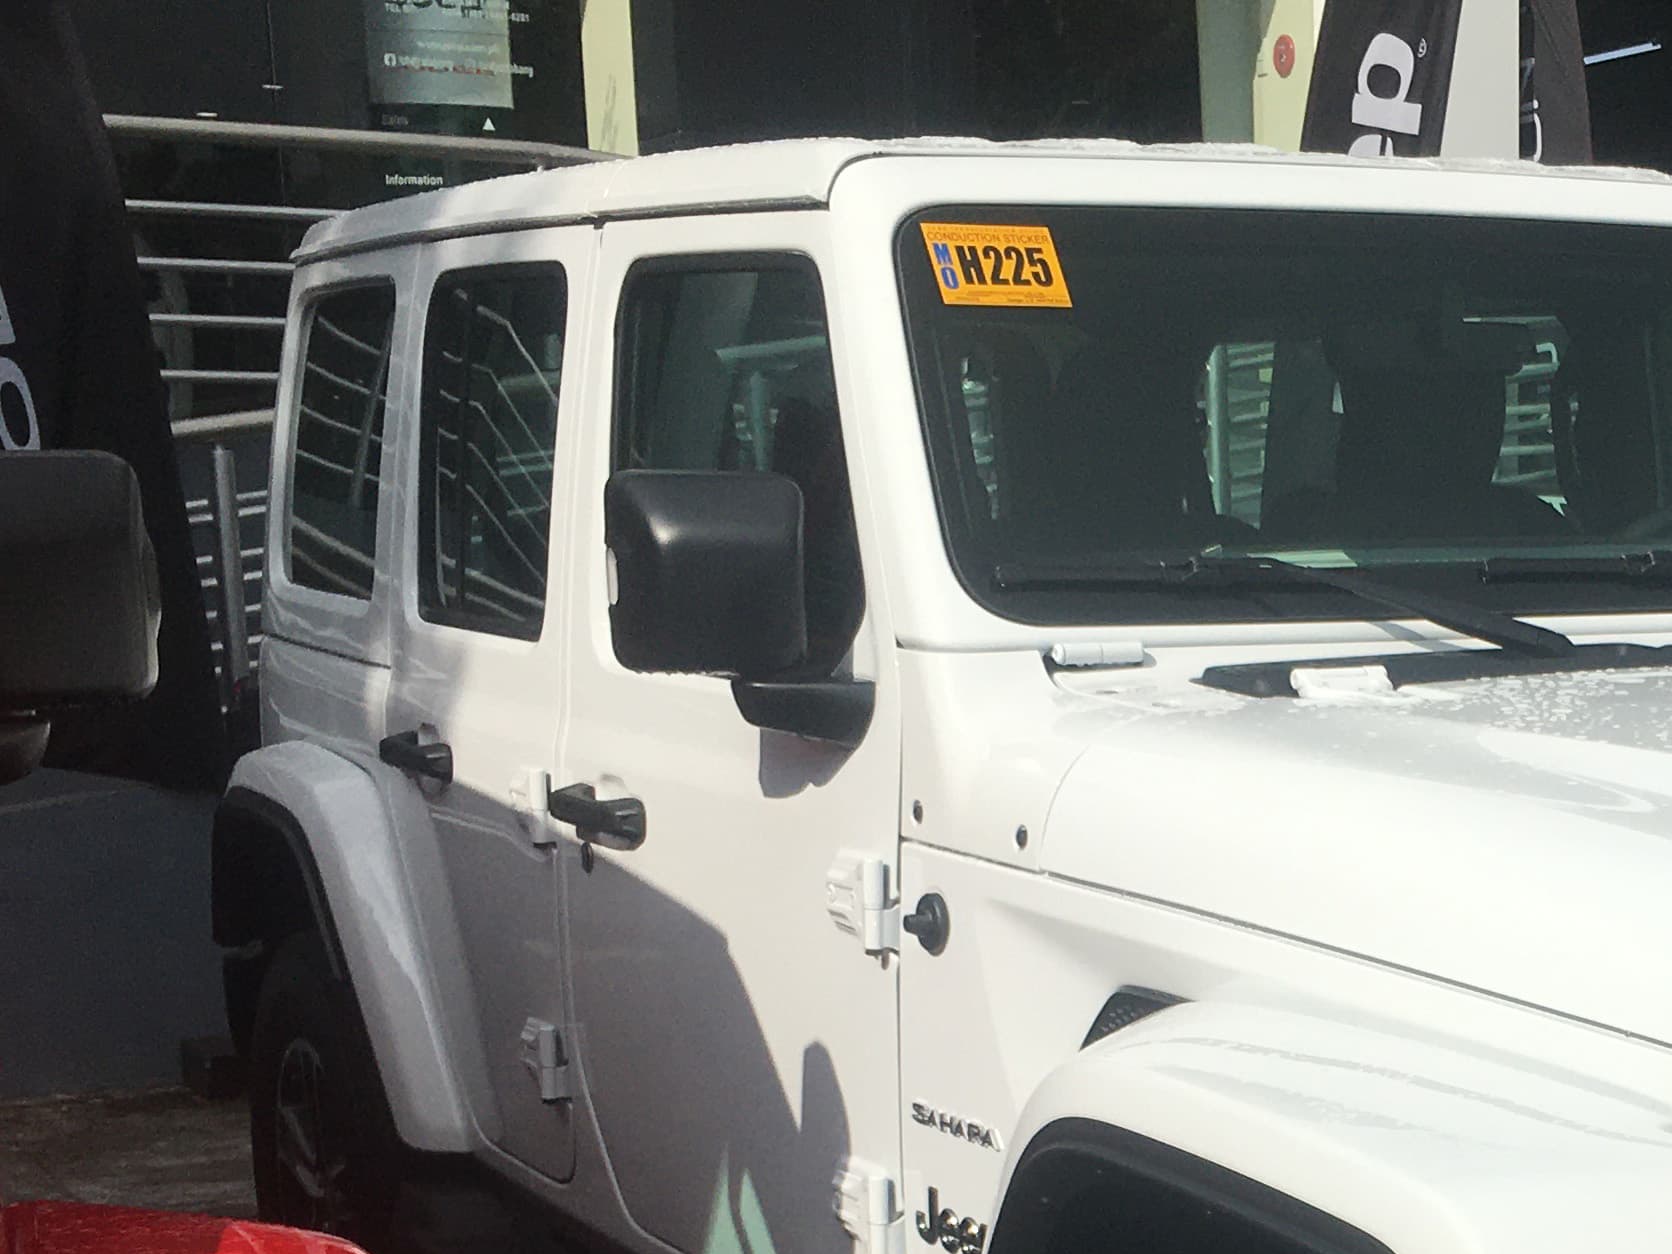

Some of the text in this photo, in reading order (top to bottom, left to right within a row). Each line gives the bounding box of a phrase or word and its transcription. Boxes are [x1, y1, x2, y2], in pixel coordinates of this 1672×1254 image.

[385, 173, 443, 187] Information
[926, 230, 1050, 245] CONDUCTION STICKER
[953, 244, 1054, 288] H225
[911, 1100, 1003, 1152] SAHARA
